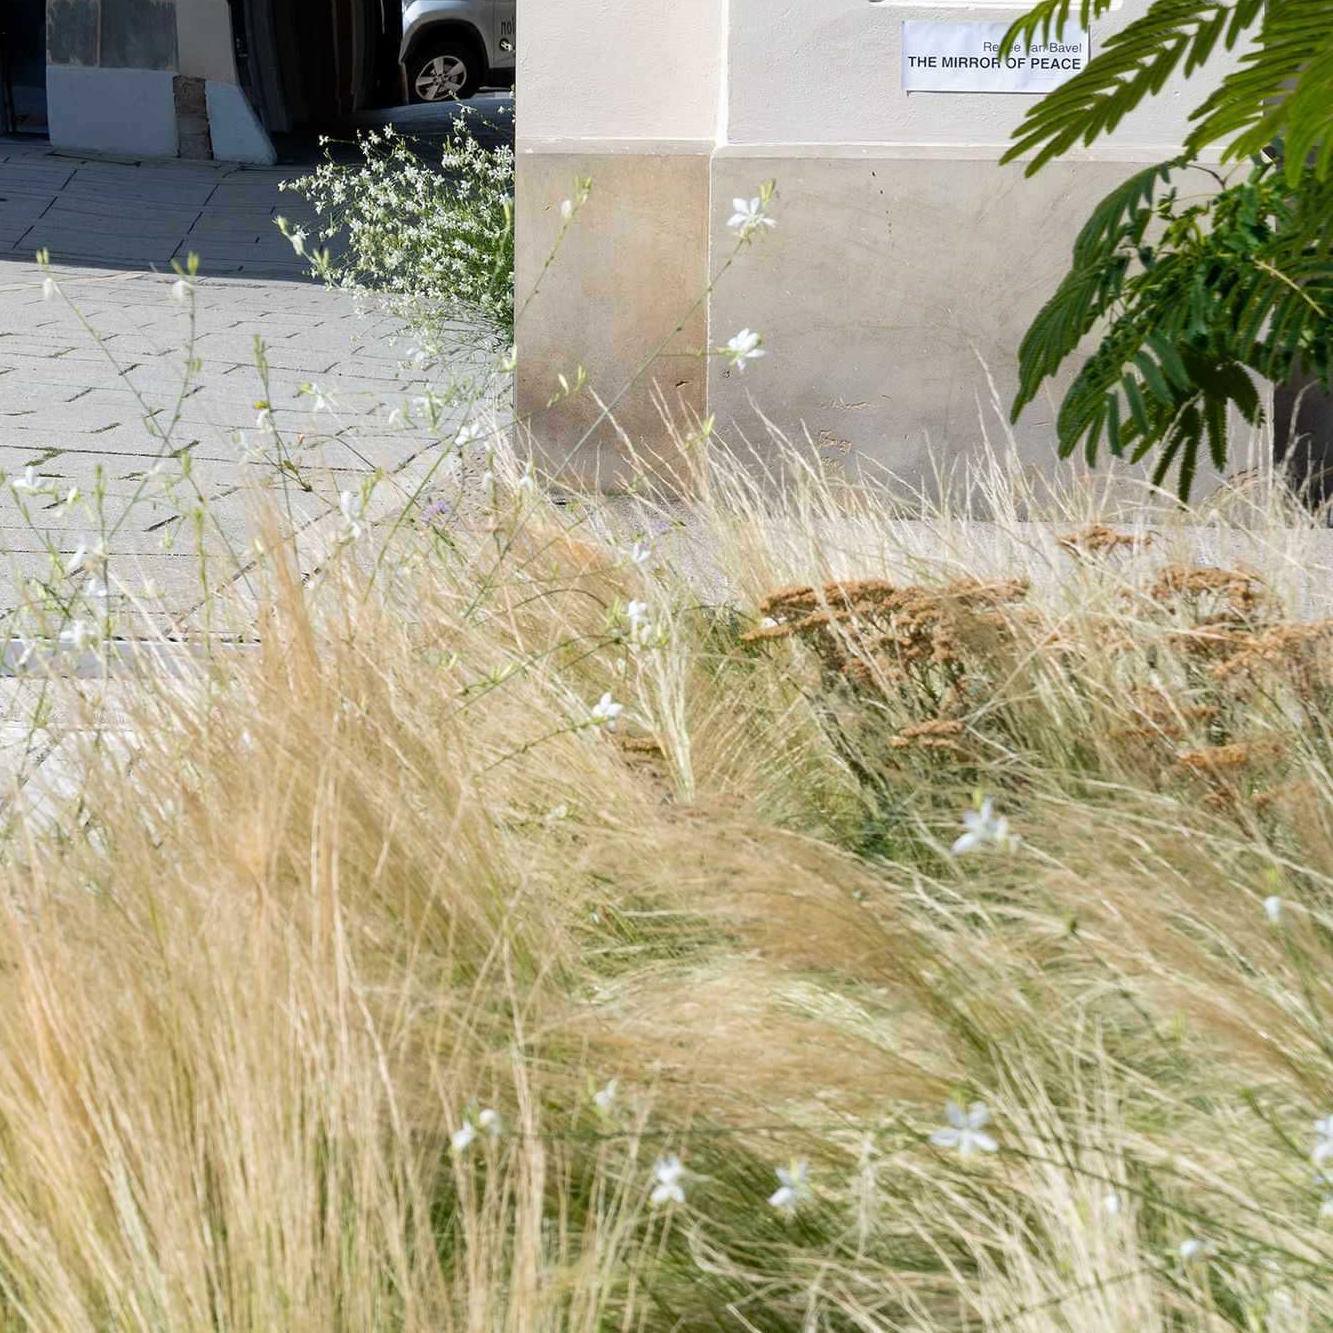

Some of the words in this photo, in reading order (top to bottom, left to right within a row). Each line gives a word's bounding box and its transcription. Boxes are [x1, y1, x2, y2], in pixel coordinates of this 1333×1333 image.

[983, 41, 1021, 53] Ree
[1049, 42, 1082, 53] Bavel
[908, 56, 937, 68] THE
[942, 57, 1001, 69] MIRROR
[1005, 57, 1026, 69] OF
[1030, 58, 1081, 70] PEACE
